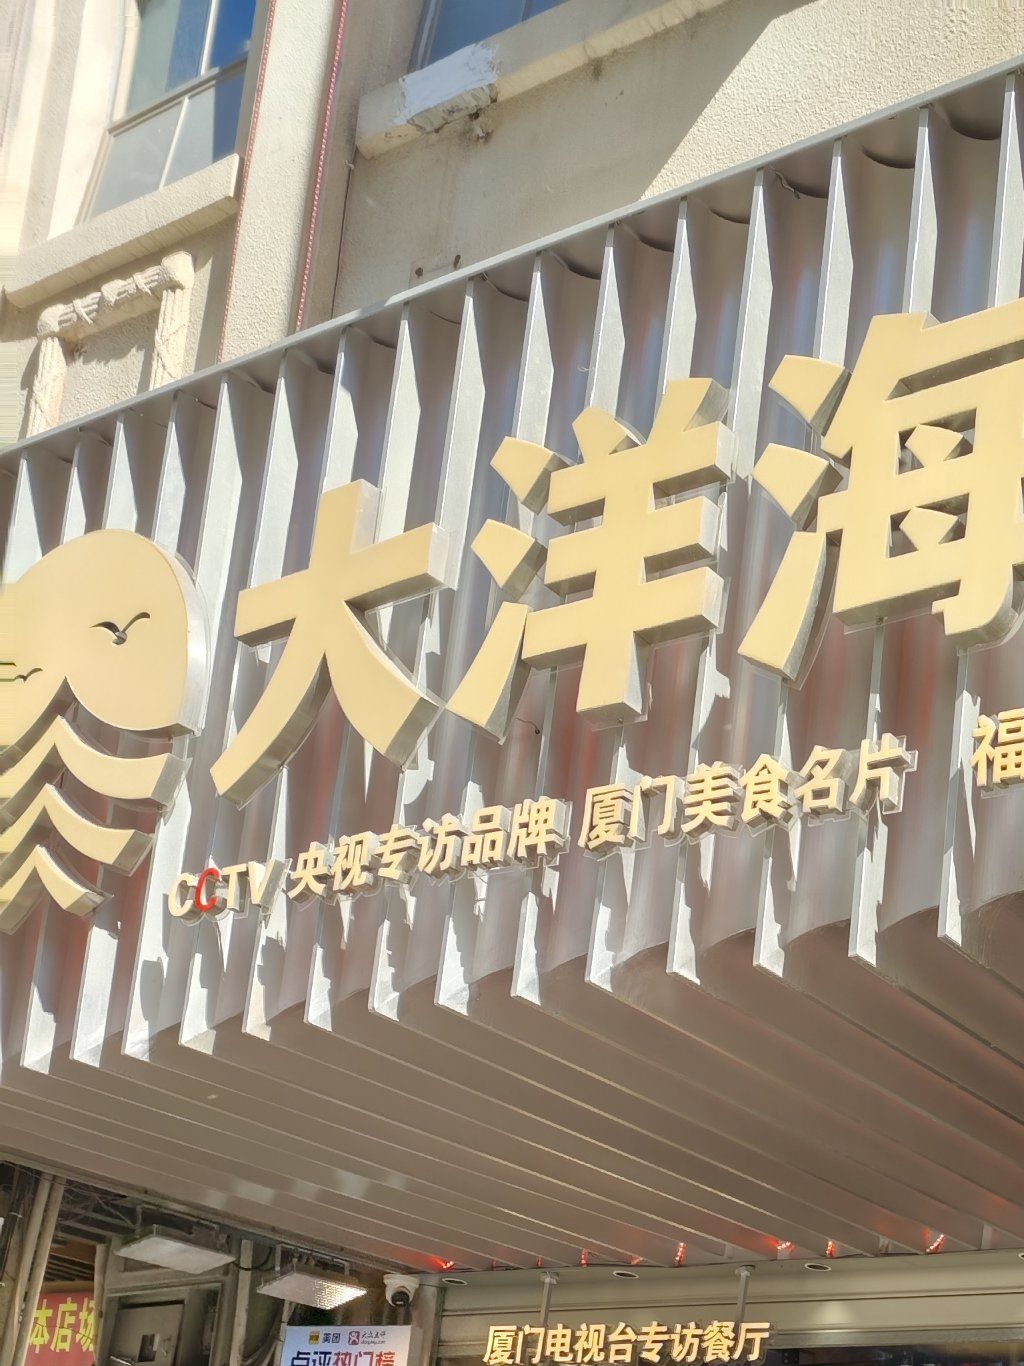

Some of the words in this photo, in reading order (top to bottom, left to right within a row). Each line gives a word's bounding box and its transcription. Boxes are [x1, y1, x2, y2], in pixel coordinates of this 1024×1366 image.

[168, 860, 288, 918] CCTV
[288, 795, 562, 898] 央视专访品牌
[578, 733, 910, 851] 厦门美食名片
[483, 1320, 770, 1365] 厦门电视台专访餐厅
